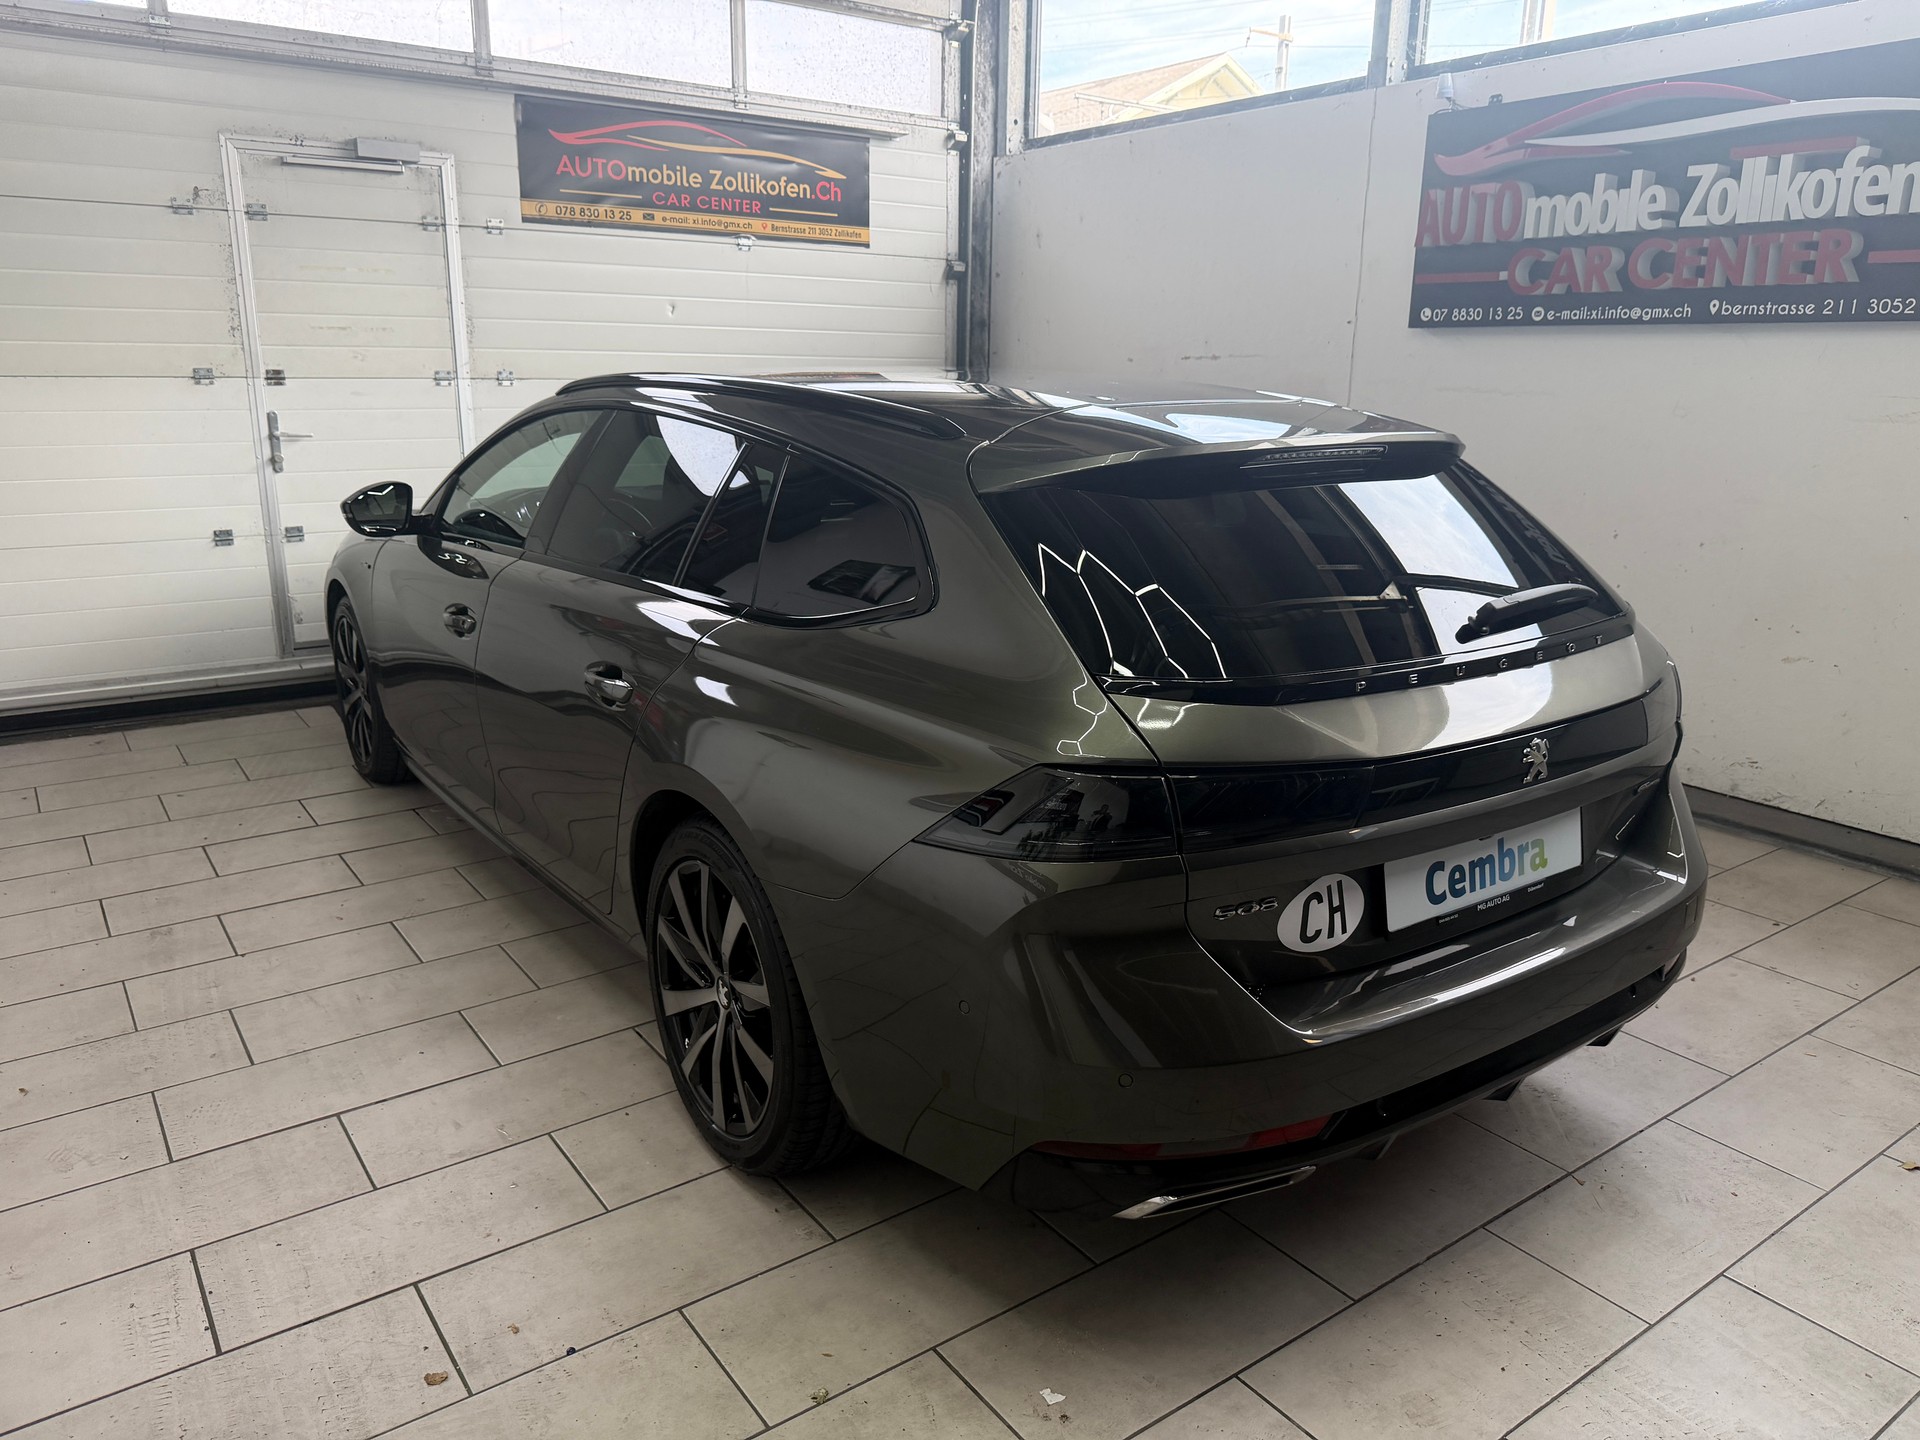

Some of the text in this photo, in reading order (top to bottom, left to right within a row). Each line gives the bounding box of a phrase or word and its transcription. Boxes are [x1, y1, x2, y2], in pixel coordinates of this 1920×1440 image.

[556, 154, 842, 202] AUTOmobile Zollikofen.Ch
[1415, 145, 1920, 247] AUTOmobile Zollikofen
[555, 205, 576, 217] 078
[579, 207, 600, 219] 830
[604, 209, 616, 219] 13
[619, 210, 632, 221] 25
[771, 223, 807, 235] Bernstrasse
[808, 226, 817, 236] 211
[818, 227, 833, 237] 3052
[834, 228, 862, 239] Zollikofen
[652, 191, 761, 214] CAR CENTER
[1507, 228, 1857, 295] CAR CENTER
[1489, 306, 1503, 320] 13
[1507, 306, 1524, 320] 25
[1721, 300, 1815, 316] bernstrasse
[1867, 297, 1917, 315] 3052
[1355, 635, 1603, 692] PEUGEOT
[1425, 837, 1548, 906] Cembra
[1213, 896, 1279, 921] 508
[1299, 879, 1348, 944] CH
[1477, 894, 1511, 911] MG AUTO AG
